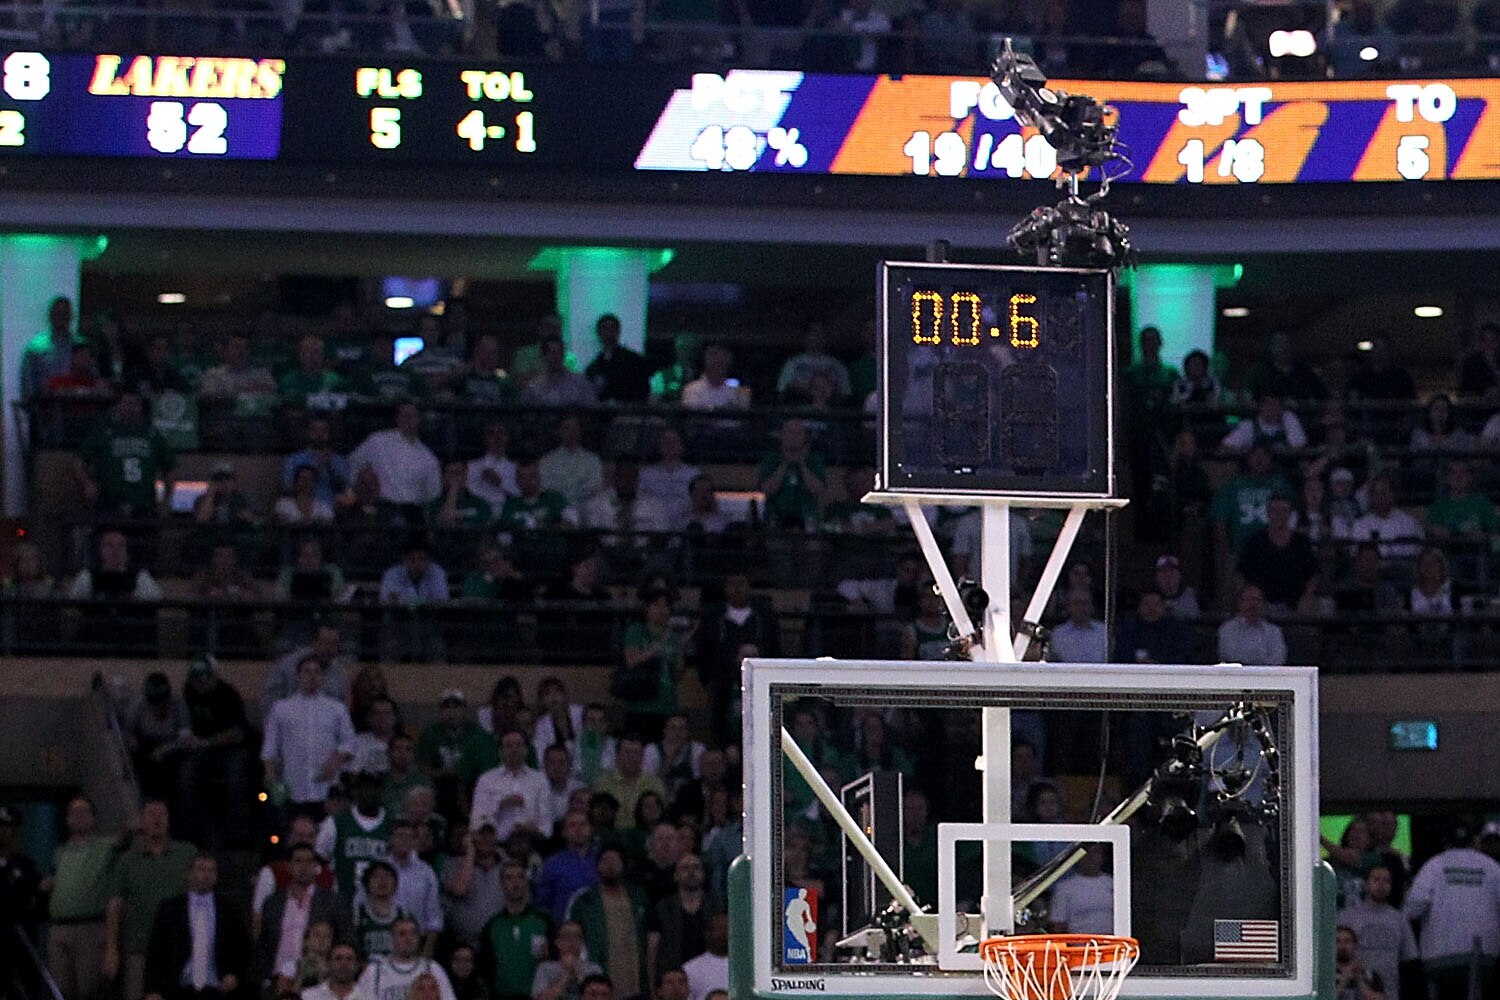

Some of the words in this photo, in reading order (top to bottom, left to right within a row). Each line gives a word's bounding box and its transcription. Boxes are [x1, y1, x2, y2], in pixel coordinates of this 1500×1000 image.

[90, 55, 285, 98] LAKERS
[463, 72, 534, 101] TOL
[1386, 85, 1456, 122] TO
[147, 102, 228, 153] 52
[370, 108, 400, 148] 5
[457, 110, 535, 152] 4-1
[912, 291, 1040, 348] 00.6
[787, 948, 806, 960] NBA
[771, 977, 825, 991] SPALDING
